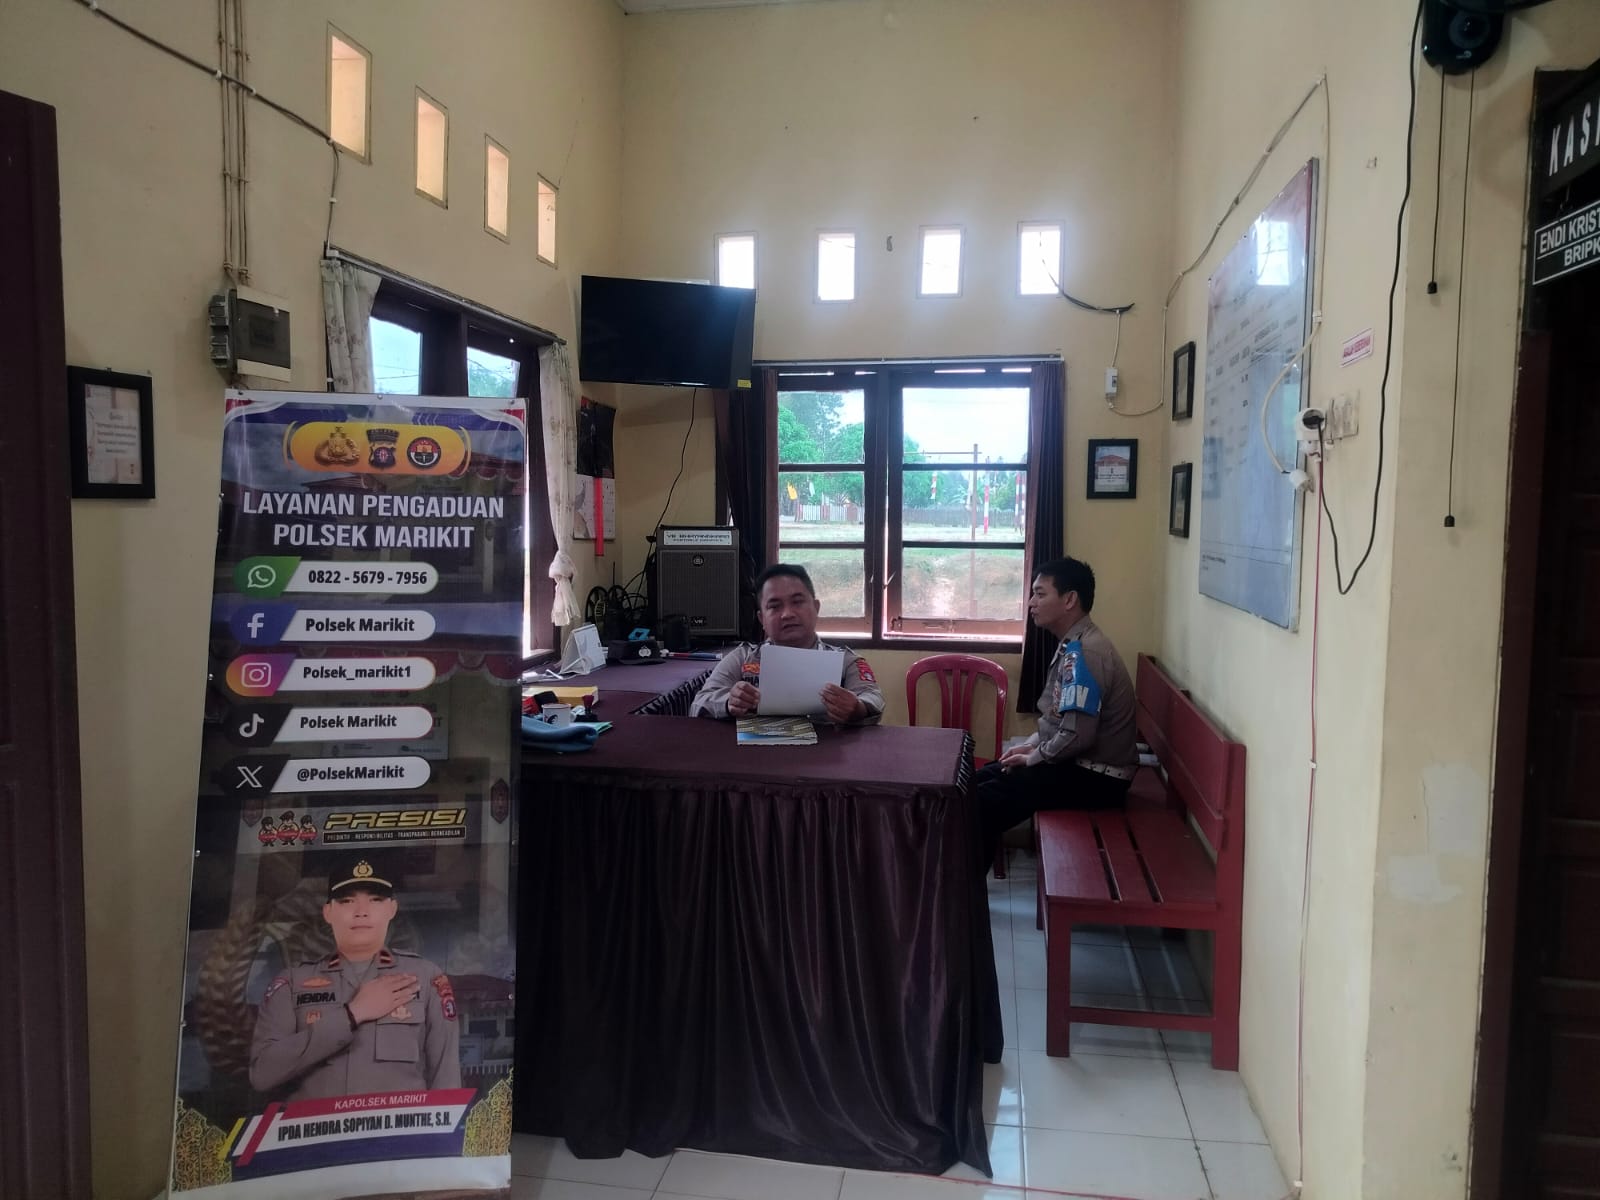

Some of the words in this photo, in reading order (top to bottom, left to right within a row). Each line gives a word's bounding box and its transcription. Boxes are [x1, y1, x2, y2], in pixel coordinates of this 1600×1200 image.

[1540, 223, 1567, 254] ENDI
[243, 491, 355, 516] LAYANAN
[362, 494, 504, 519] PENGADUAN
[273, 523, 368, 547] POLSEK
[375, 525, 475, 549] MARIKIT
[308, 569, 341, 584] 0822
[352, 570, 385, 585] 5679
[396, 571, 428, 585] 7956
[305, 618, 355, 632] Polsek
[359, 617, 415, 632] Marikit
[303, 664, 411, 681] Polsek_marikit1
[300, 715, 345, 729] Polsek
[347, 714, 397, 728] Marikit
[297, 764, 405, 782] @PolsekMarikit
[324, 808, 467, 831] PRESISI
[296, 991, 336, 1006] HENDRA
[335, 1096, 387, 1111] KAPOLSEK
[389, 1093, 427, 1106] MARIKIT
[278, 1123, 302, 1142] IPDA
[303, 1119, 342, 1139] HENDRA
[343, 1116, 382, 1135] SOPIYAN
[384, 1115, 393, 1130] D.
[395, 1112, 434, 1129] MUNTHE,
[435, 1111, 452, 1127] S.H.
